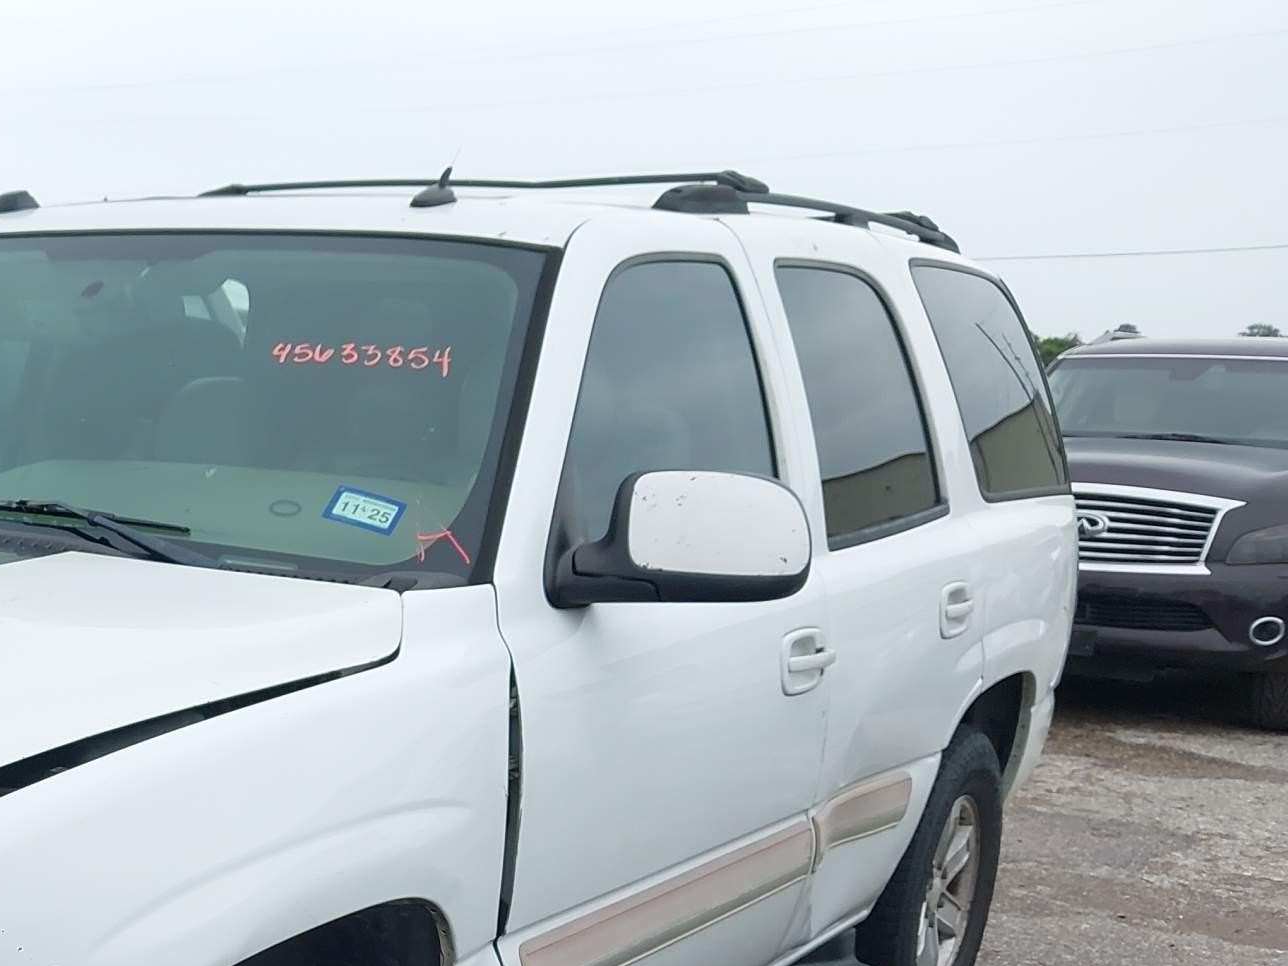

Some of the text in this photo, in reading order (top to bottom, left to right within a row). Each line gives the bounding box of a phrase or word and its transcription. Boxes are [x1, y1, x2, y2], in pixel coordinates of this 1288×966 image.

[271, 342, 452, 378] 45633854
[340, 500, 361, 516] 11
[367, 507, 392, 524] 25
